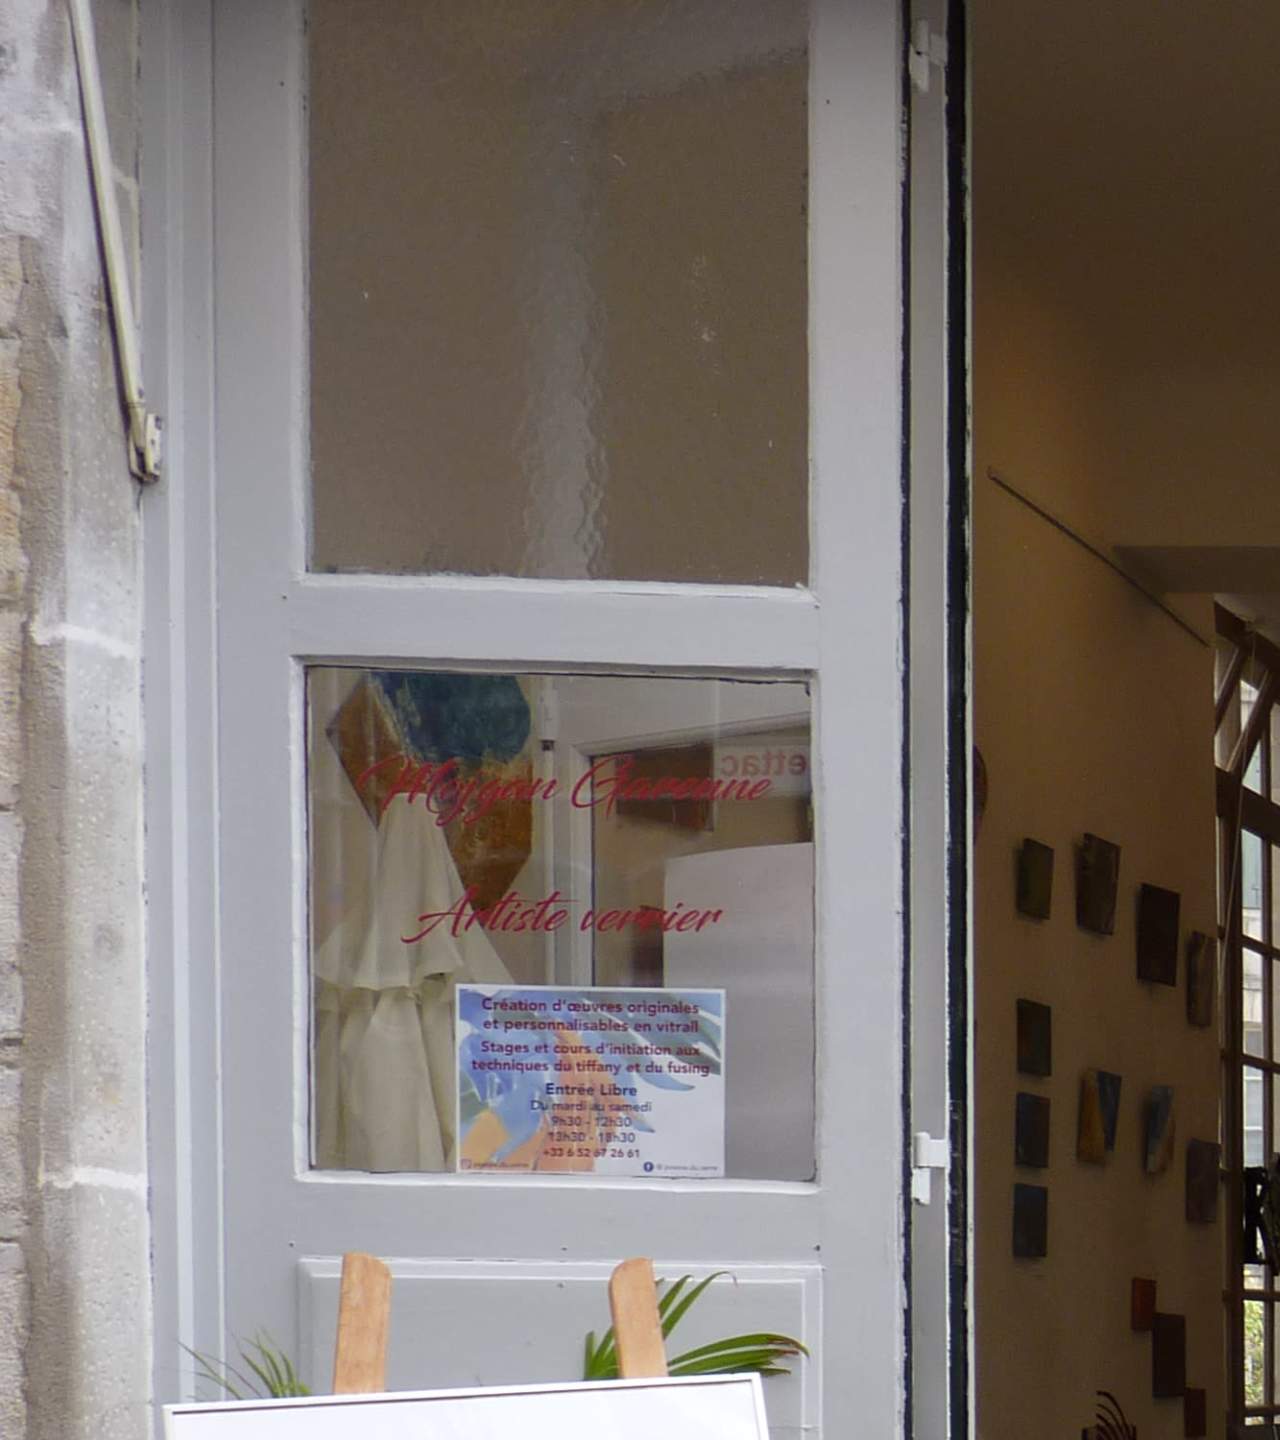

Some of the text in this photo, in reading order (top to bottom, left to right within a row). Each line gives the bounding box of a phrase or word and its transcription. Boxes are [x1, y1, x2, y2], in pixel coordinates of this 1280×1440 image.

[400, 886, 723, 944] Artiste verrier
[482, 997, 547, 1011] Création
[627, 1000, 699, 1017] originales
[483, 1018, 699, 1033] et personnalisables en vitrail
[481, 1041, 700, 1056] Stages et cours d'initiation aux
[472, 1059, 710, 1077] techniques du tiffany et du fusing
[545, 1082, 638, 1097] Entrée Libre
[530, 1100, 653, 1112] Du mardi au samedi
